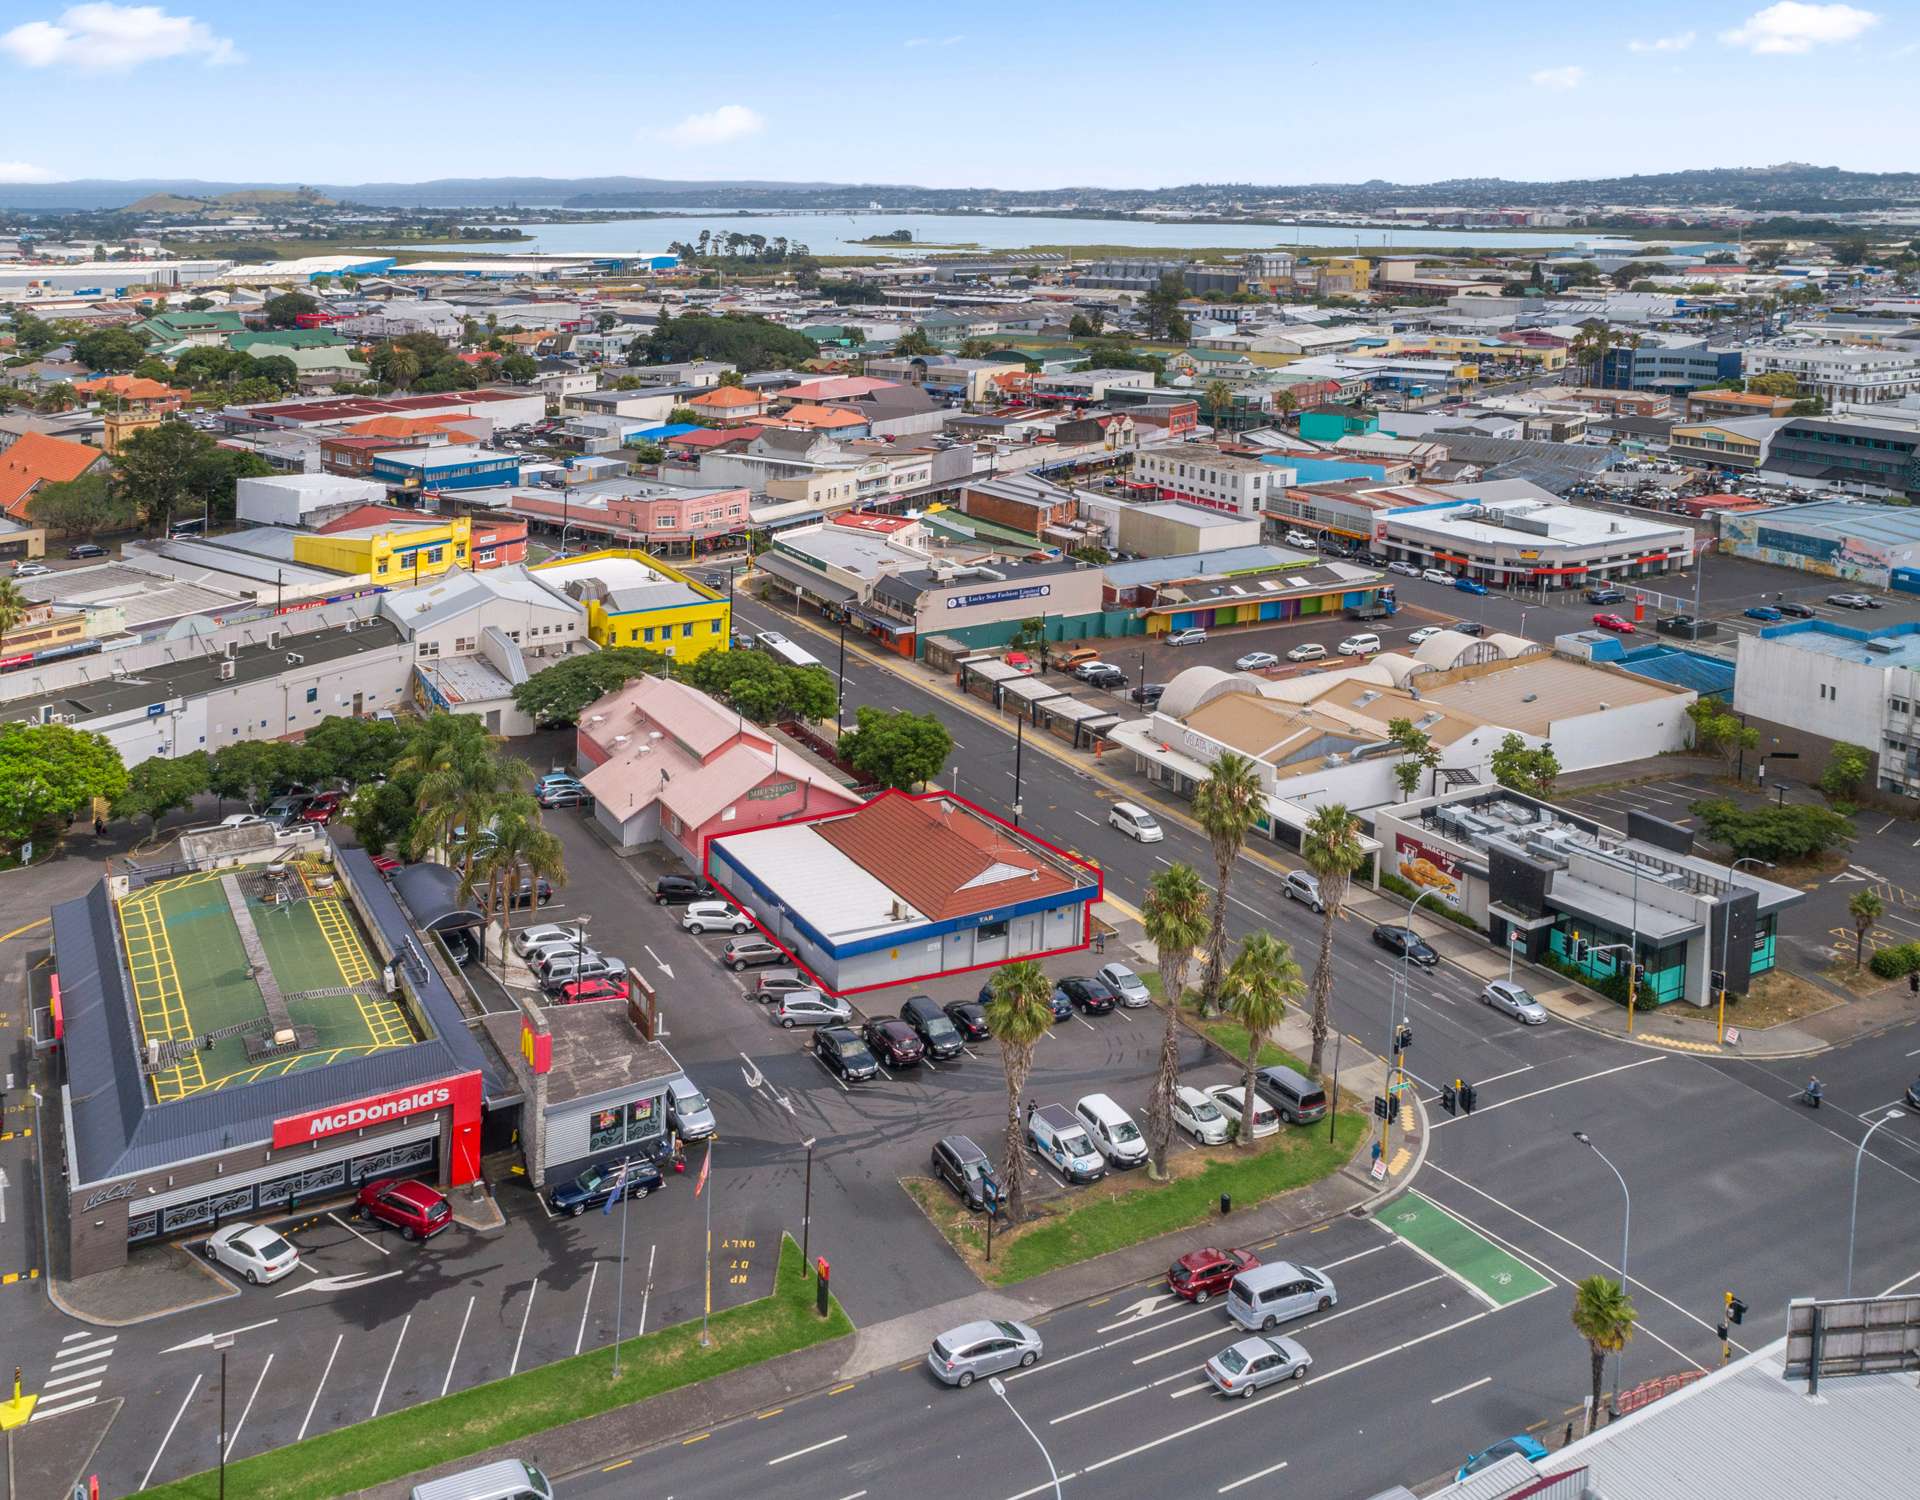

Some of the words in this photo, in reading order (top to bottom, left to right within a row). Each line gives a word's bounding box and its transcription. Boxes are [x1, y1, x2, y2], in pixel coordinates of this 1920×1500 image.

[997, 590, 1019, 598] Fashion
[1019, 587, 1040, 595] Limited
[750, 783, 795, 797] MILESTONE
[1446, 893, 1461, 904] KFC
[309, 1087, 450, 1136] McDonald's
[721, 1239, 756, 1249] ONLY
